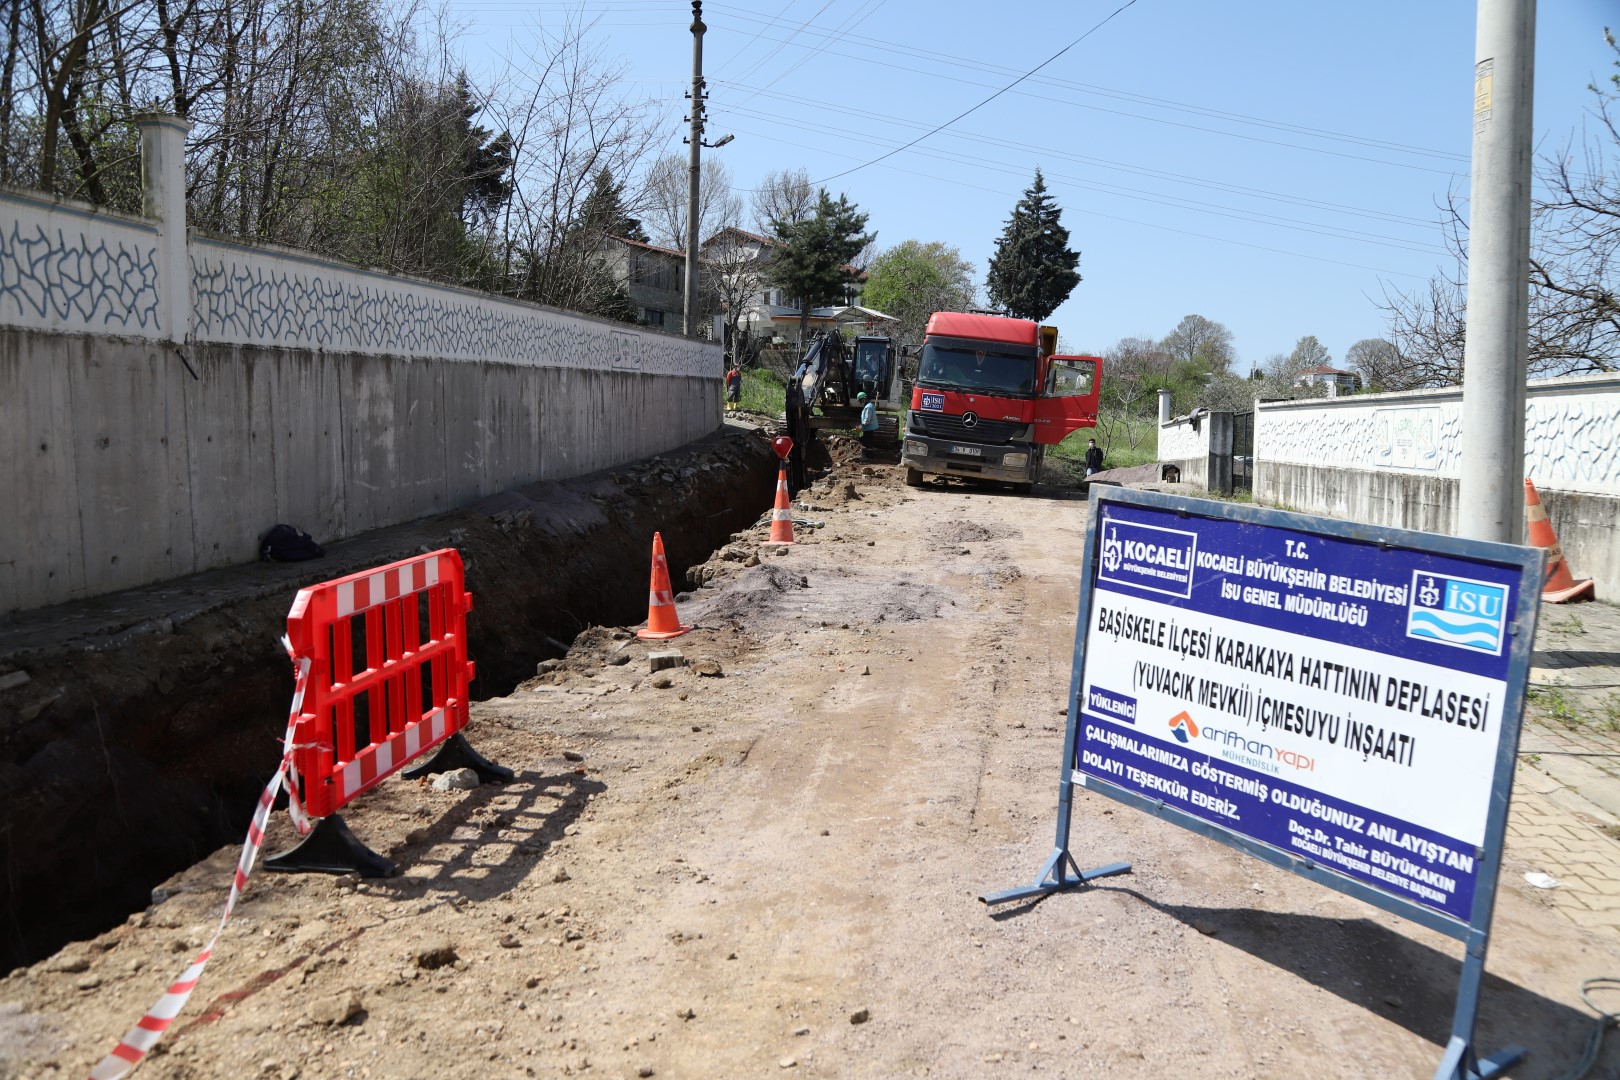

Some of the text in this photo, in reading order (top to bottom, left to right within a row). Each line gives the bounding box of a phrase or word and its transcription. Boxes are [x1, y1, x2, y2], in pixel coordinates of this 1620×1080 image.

[1124, 539, 1191, 571] KOCAELİ
[1285, 539, 1309, 560] T.C.
[1196, 550, 1408, 607] KOCAELİ BÜYÜKŞEHİR BELEDİYESİ
[1221, 577, 1368, 627] İSU GENEL MÜDÜRLÜĞÜ
[1447, 584, 1502, 617] İSU
[1098, 606, 1490, 733] BAŞİSKELE İLÇESİ KARAKAYA HATTININ DEPLASESİ
[1090, 692, 1136, 720] YÜKLENİCİ
[1197, 681, 1254, 728] MEVKİİ)
[1254, 687, 1340, 745] İÇMESUYU
[1344, 711, 1416, 768] İNŞAATI
[1082, 750, 1241, 821] DOLAYI TEŞEKKÜR EDERİZ.
[1221, 748, 1281, 776] MÜHENDİSLİK
[1085, 724, 1473, 874] ÇALIŞMALARIMIZA GÖSTERMİŞ OLDUĞUNUZ ANLAYIŞTAN
[1288, 818, 1456, 894] Doç.Dr. Tahir BÜYÜKAKIN
